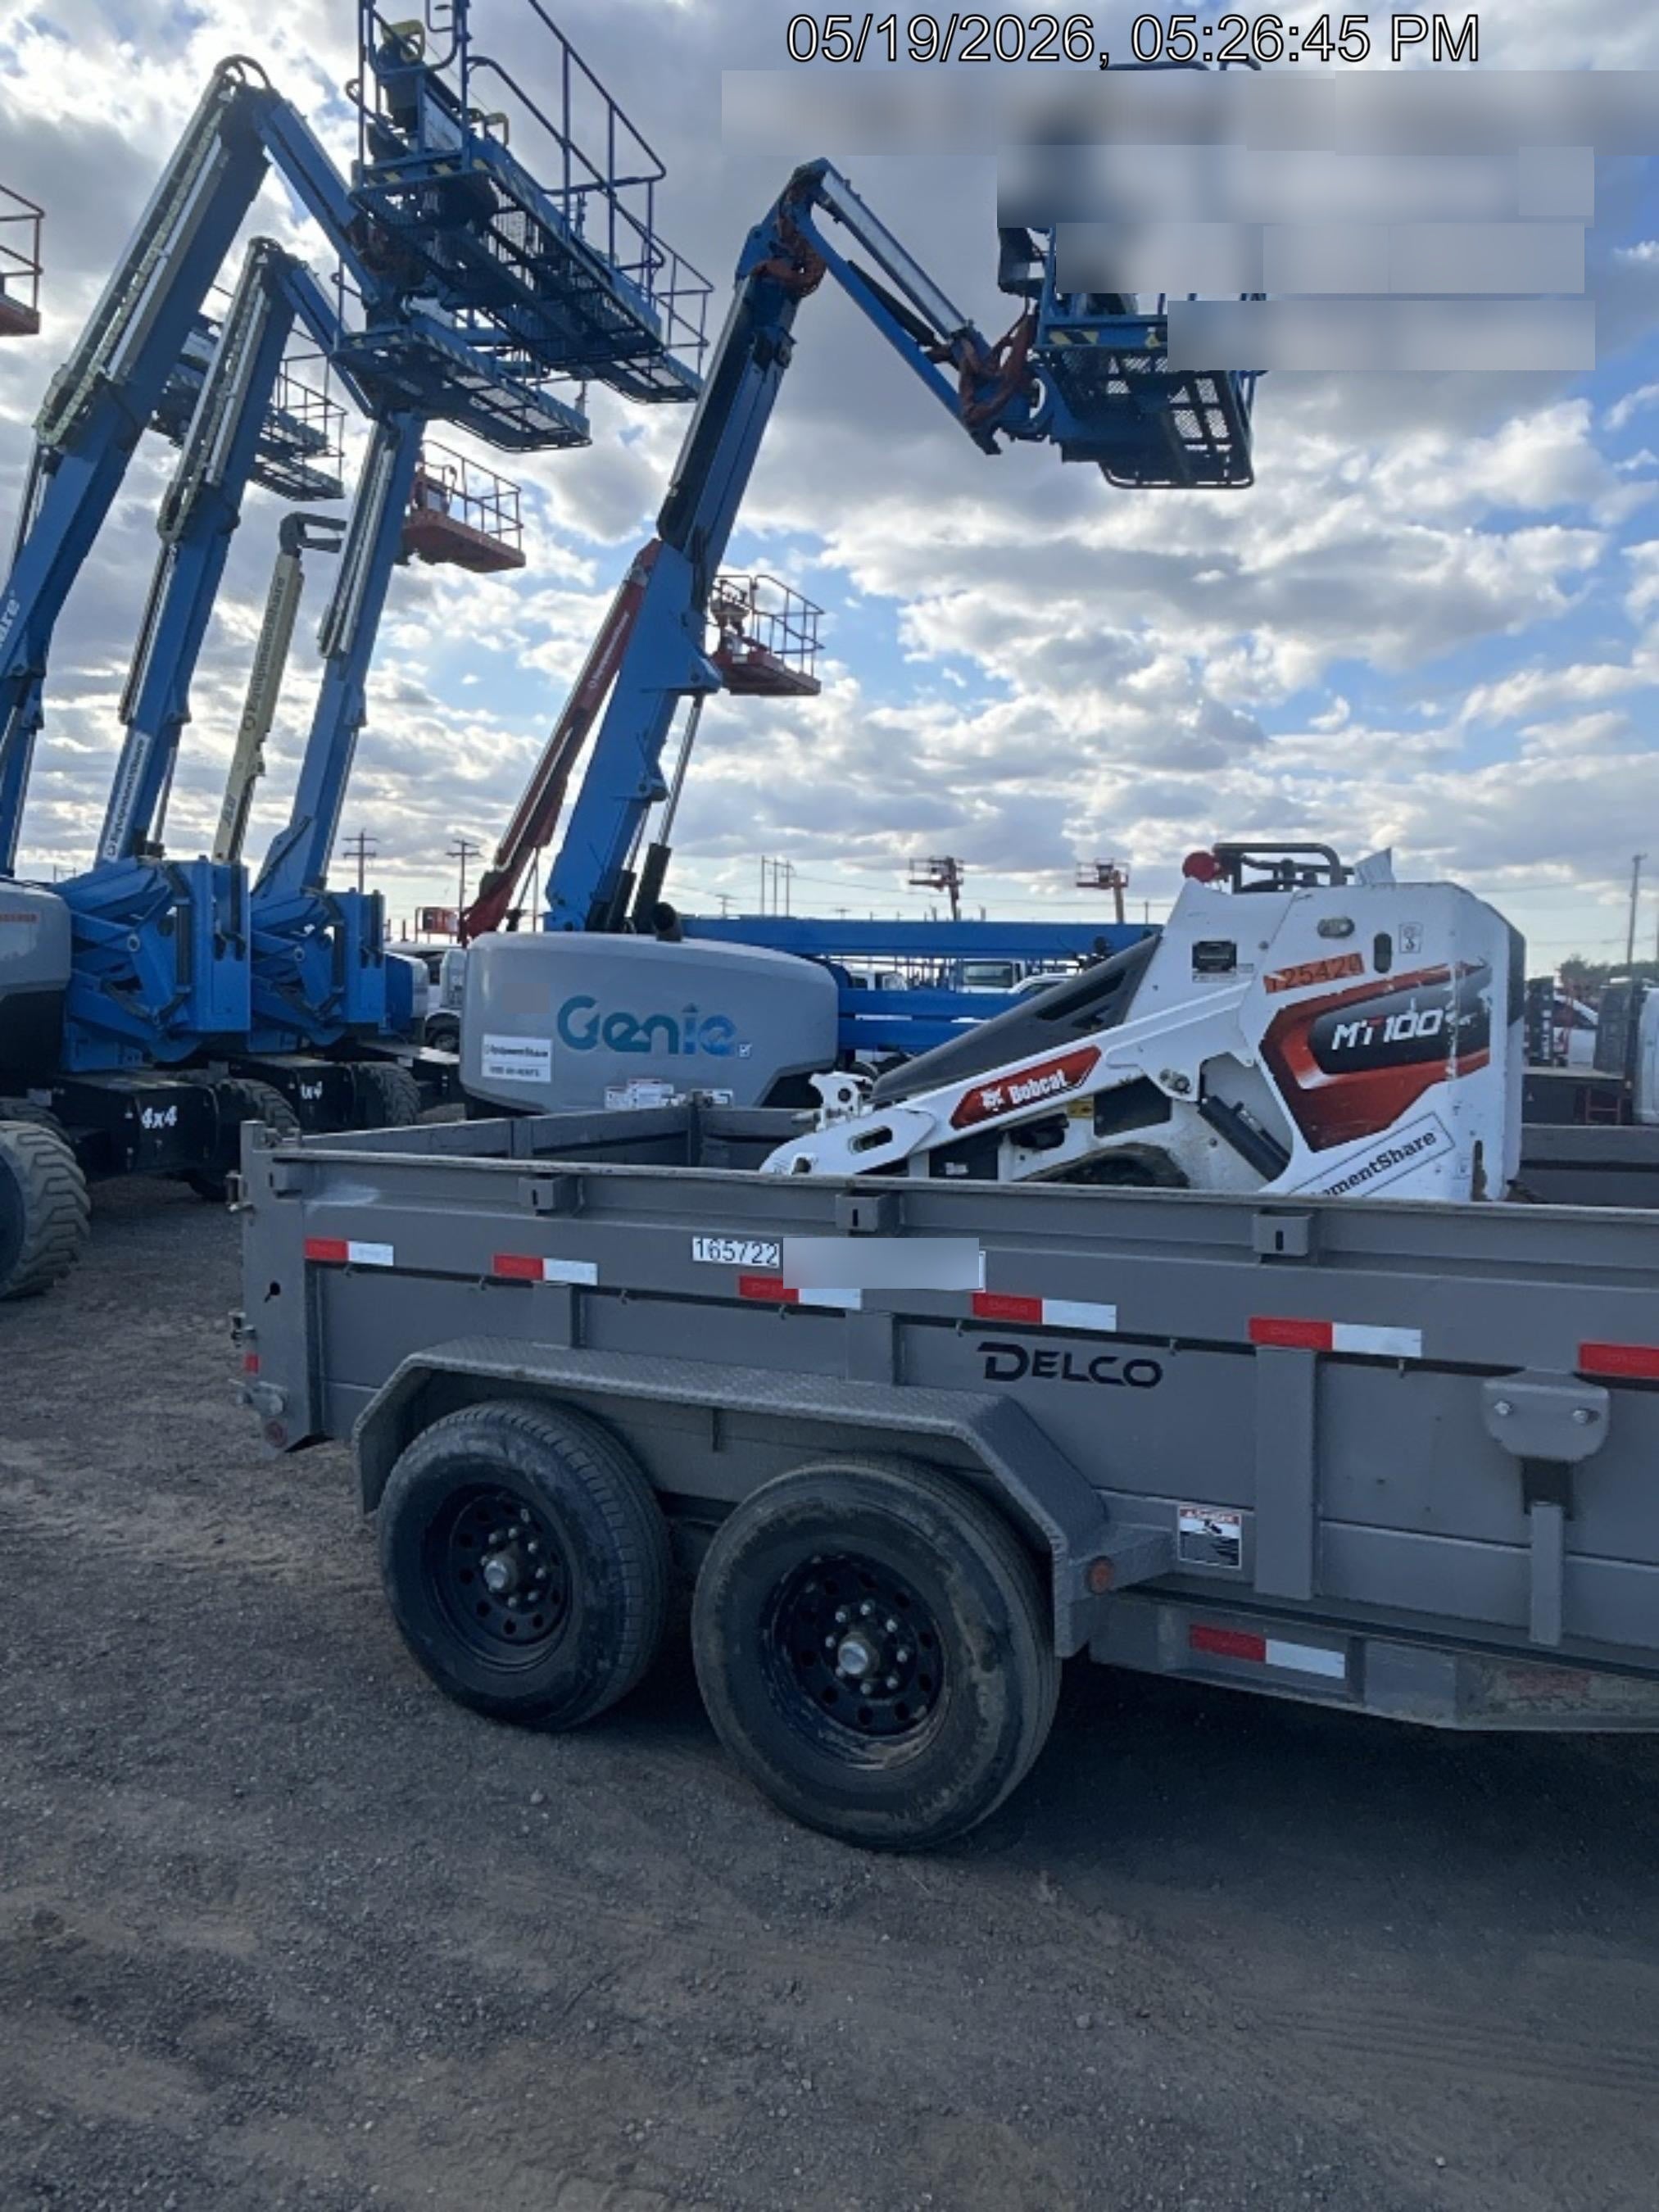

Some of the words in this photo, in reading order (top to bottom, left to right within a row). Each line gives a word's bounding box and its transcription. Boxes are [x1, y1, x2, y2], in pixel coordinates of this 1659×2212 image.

[557, 995, 735, 1057] Genie
[1009, 1067, 1067, 1104] Bobcat
[141, 1105, 178, 1129] 4x4
[1321, 1131, 1437, 1196] mentShare
[696, 1238, 777, 1267] 165722
[977, 1341, 1163, 1388] DELCO
